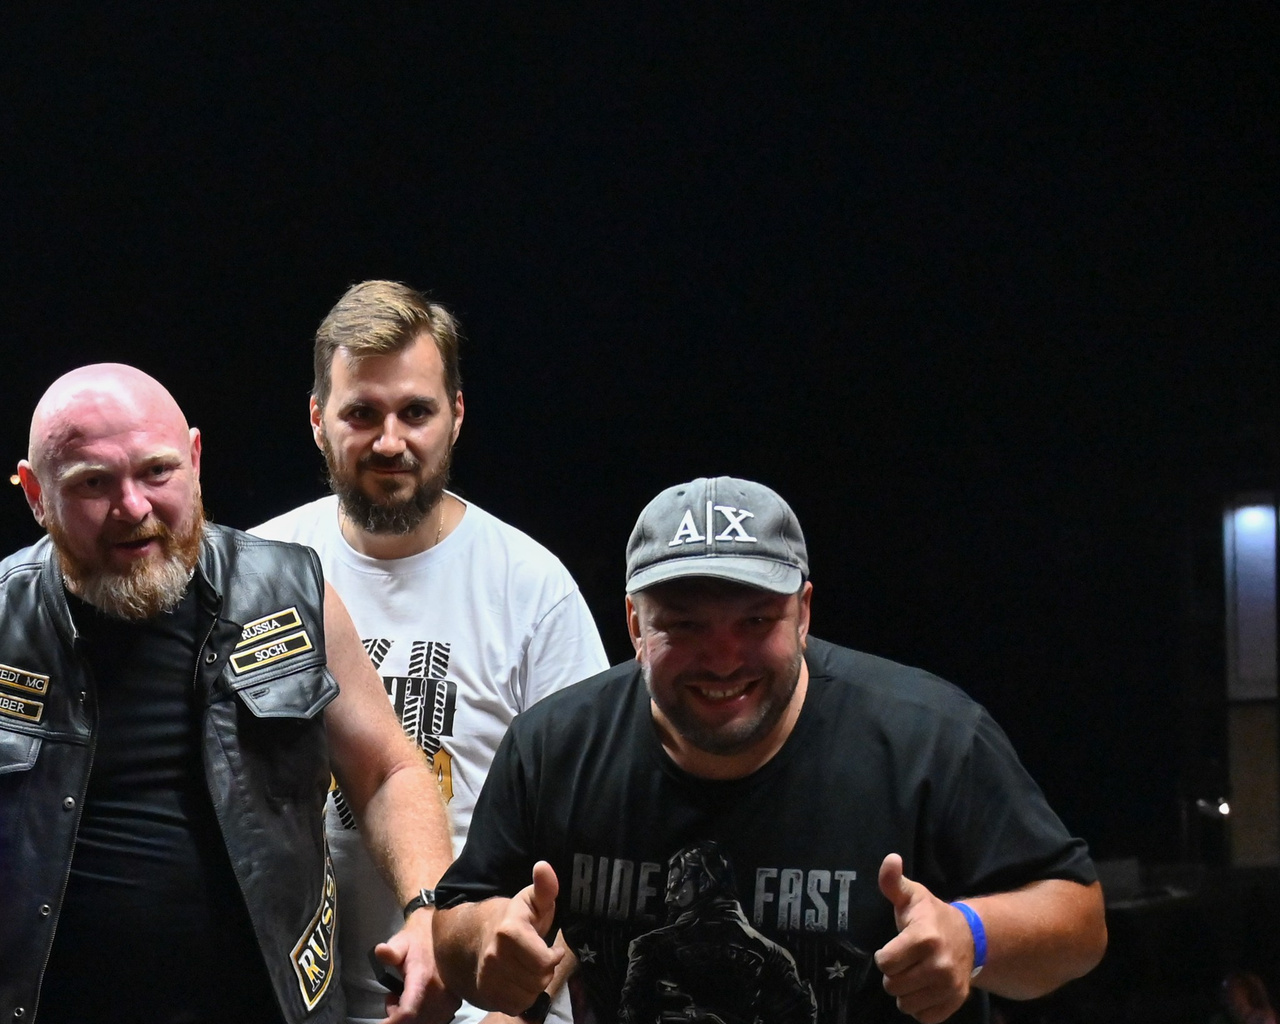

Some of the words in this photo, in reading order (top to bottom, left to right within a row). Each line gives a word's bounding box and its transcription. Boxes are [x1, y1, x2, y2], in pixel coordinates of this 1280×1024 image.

[241, 618, 281, 641] RUSSIA
[254, 642, 289, 662] SOCHI
[25, 676, 45, 690] MC
[570, 852, 661, 921] RIDE
[753, 867, 857, 933] FAST
